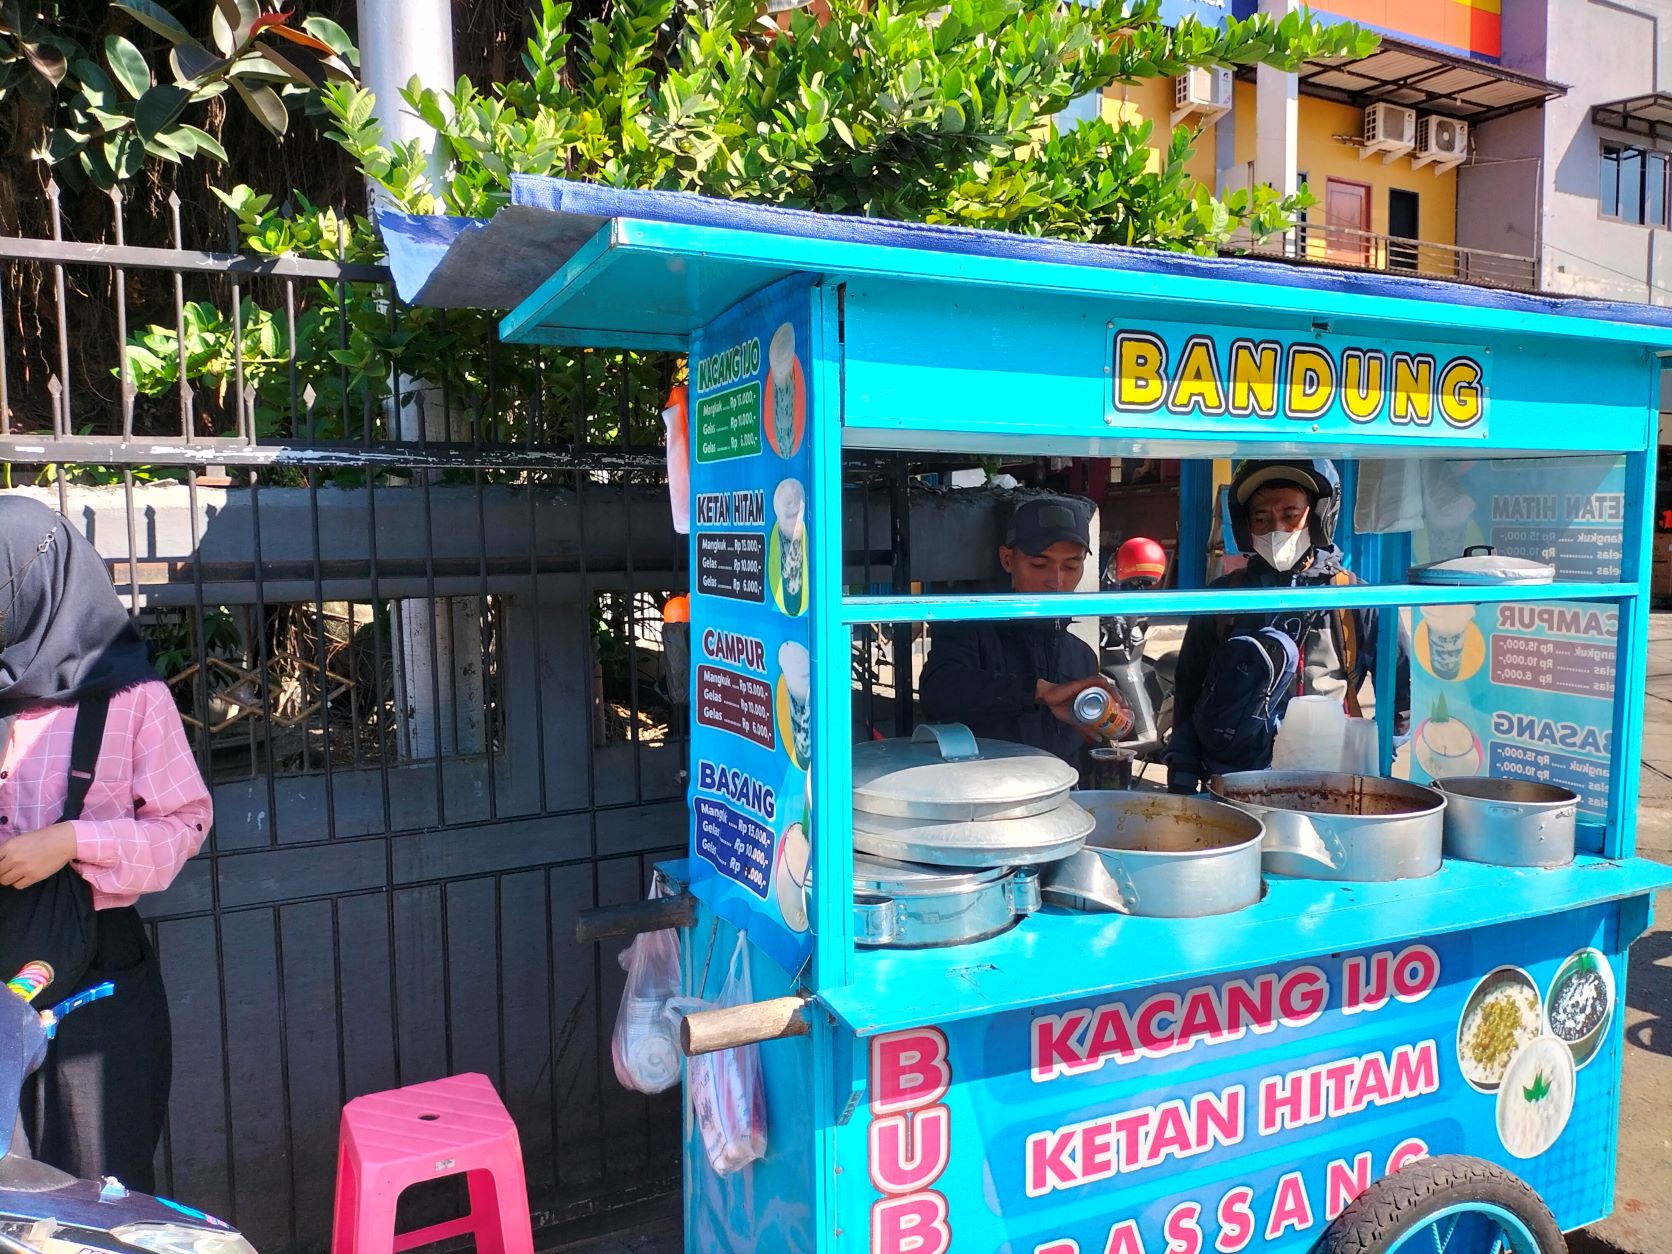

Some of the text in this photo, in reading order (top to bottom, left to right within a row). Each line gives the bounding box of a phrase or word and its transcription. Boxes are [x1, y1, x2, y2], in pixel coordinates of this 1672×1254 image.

[698, 346, 740, 393] KACANG
[1113, 329, 1485, 430] BANDUNG
[730, 396, 737, 411] Rp
[731, 417, 738, 432] Rp
[731, 437, 738, 452] Rp
[697, 489, 765, 526] KETAN HITAM
[702, 539, 727, 553] Mangkuk
[735, 539, 741, 554] Rp
[702, 557, 717, 569] Gelas
[734, 559, 740, 573] Rp
[703, 576, 717, 588] Gelas
[733, 578, 740, 593] Rp
[702, 627, 767, 674] CAMPUR
[704, 670, 731, 687] Mangkuk
[739, 679, 746, 693] Rp
[704, 688, 722, 702] Gelas
[741, 699, 748, 713] Rp
[704, 707, 722, 721] Gelas
[742, 718, 749, 733] Rp
[698, 759, 775, 822] BASANG
[702, 820, 719, 837] Gelas
[734, 838, 744, 855] Rp
[738, 819, 747, 835] Rp
[702, 838, 717, 856] Gelas
[730, 857, 740, 874] Rp
[1030, 945, 1440, 1083] KACANG IJO
[1026, 1038, 1439, 1198] KETAN HITAM
